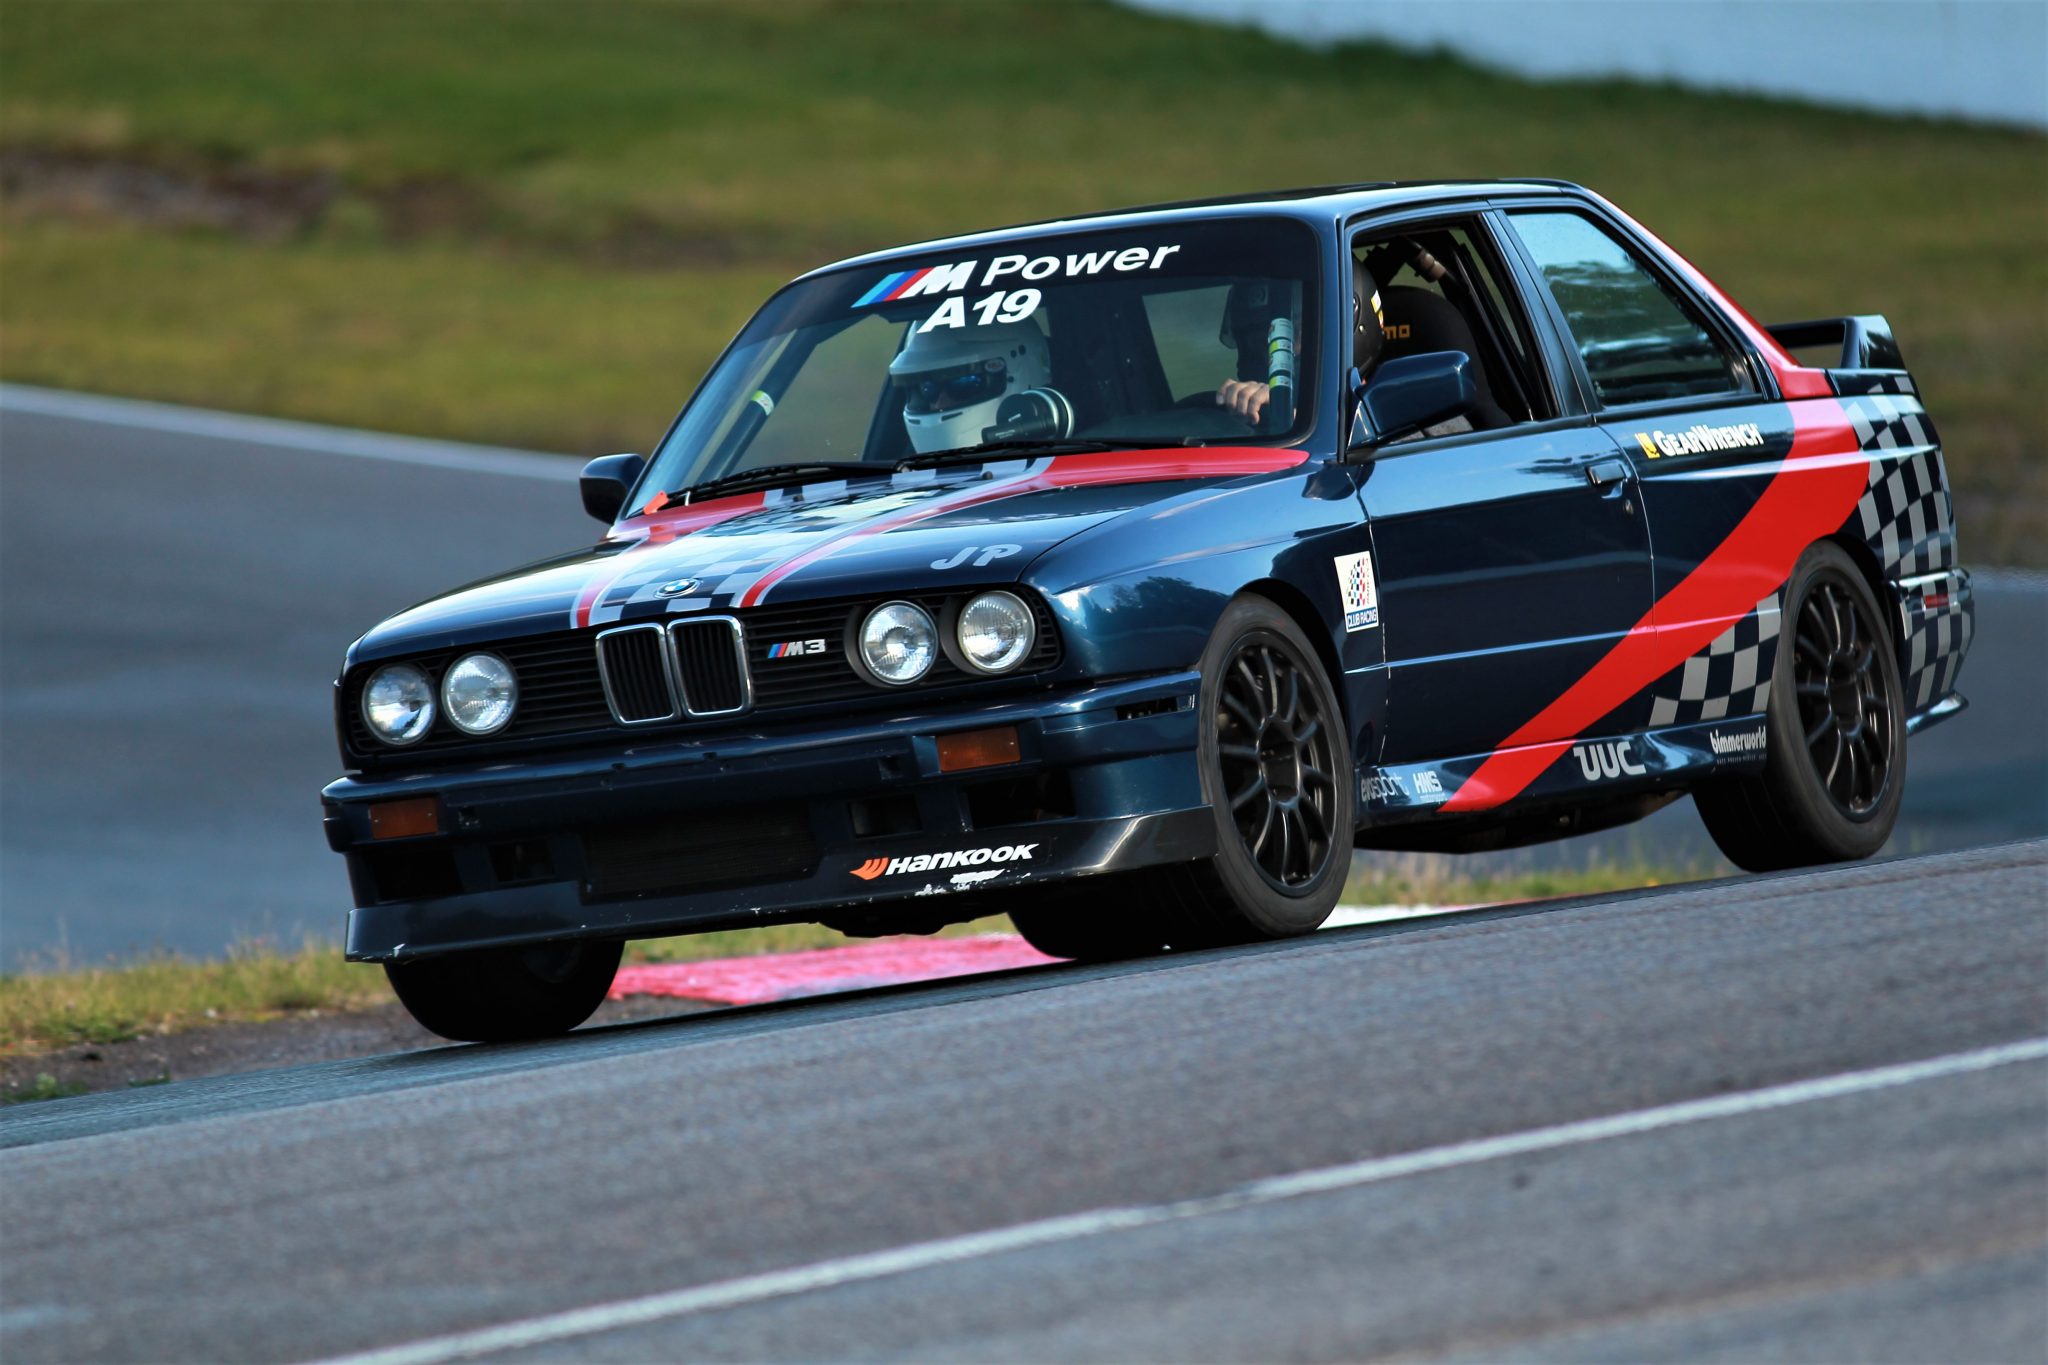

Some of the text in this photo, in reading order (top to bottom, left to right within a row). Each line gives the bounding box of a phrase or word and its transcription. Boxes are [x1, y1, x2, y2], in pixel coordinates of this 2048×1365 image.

[981, 245, 1181, 287] Power
[917, 289, 1042, 334] A19
[930, 544, 1023, 570] JP
[1347, 613, 1360, 628] CLUB
[784, 638, 826, 657] M3
[1710, 726, 1767, 754] bimmerworld
[1573, 741, 1647, 781] UUC
